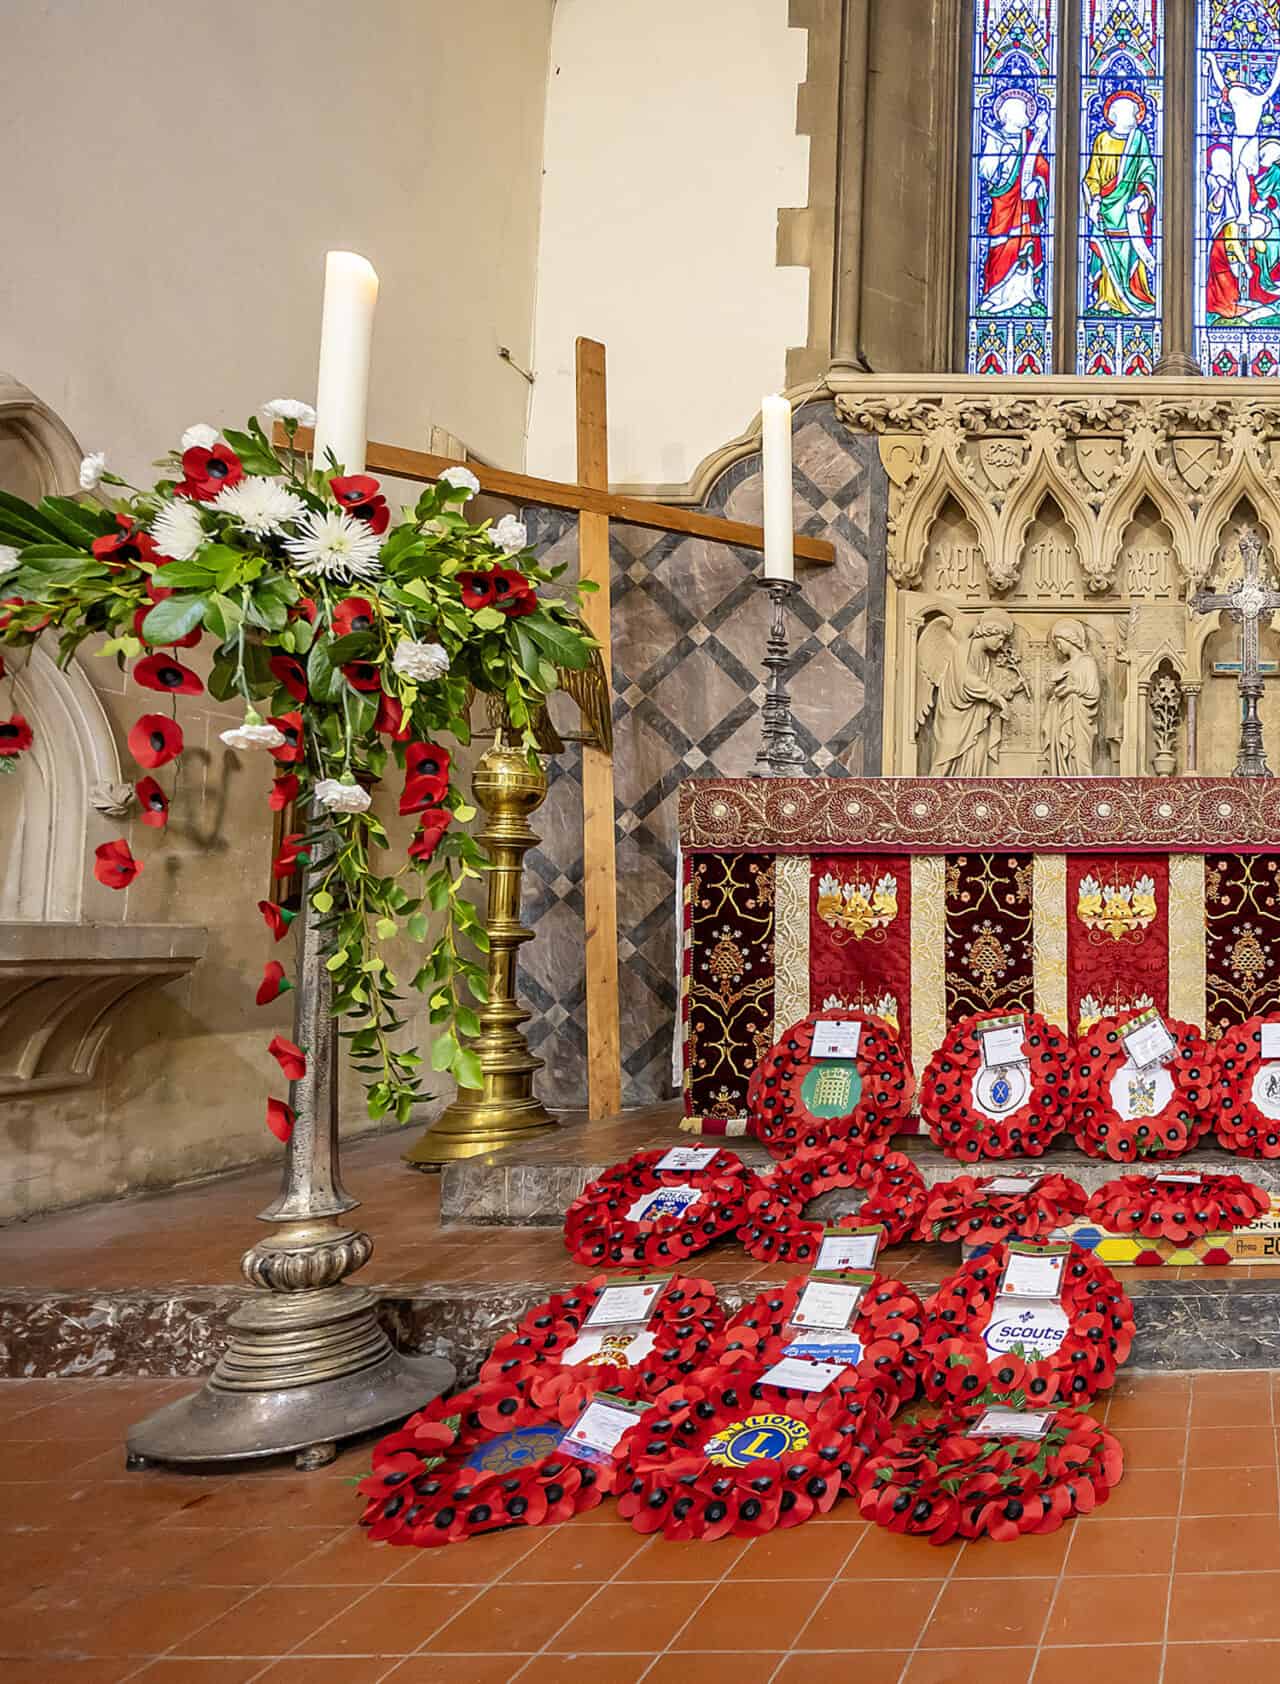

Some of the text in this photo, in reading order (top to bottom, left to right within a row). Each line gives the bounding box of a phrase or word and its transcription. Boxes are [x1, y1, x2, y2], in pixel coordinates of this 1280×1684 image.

[1000, 1326, 1065, 1340] scouts
[752, 1415, 806, 1435] LIONS
[740, 1431, 774, 1458] L
